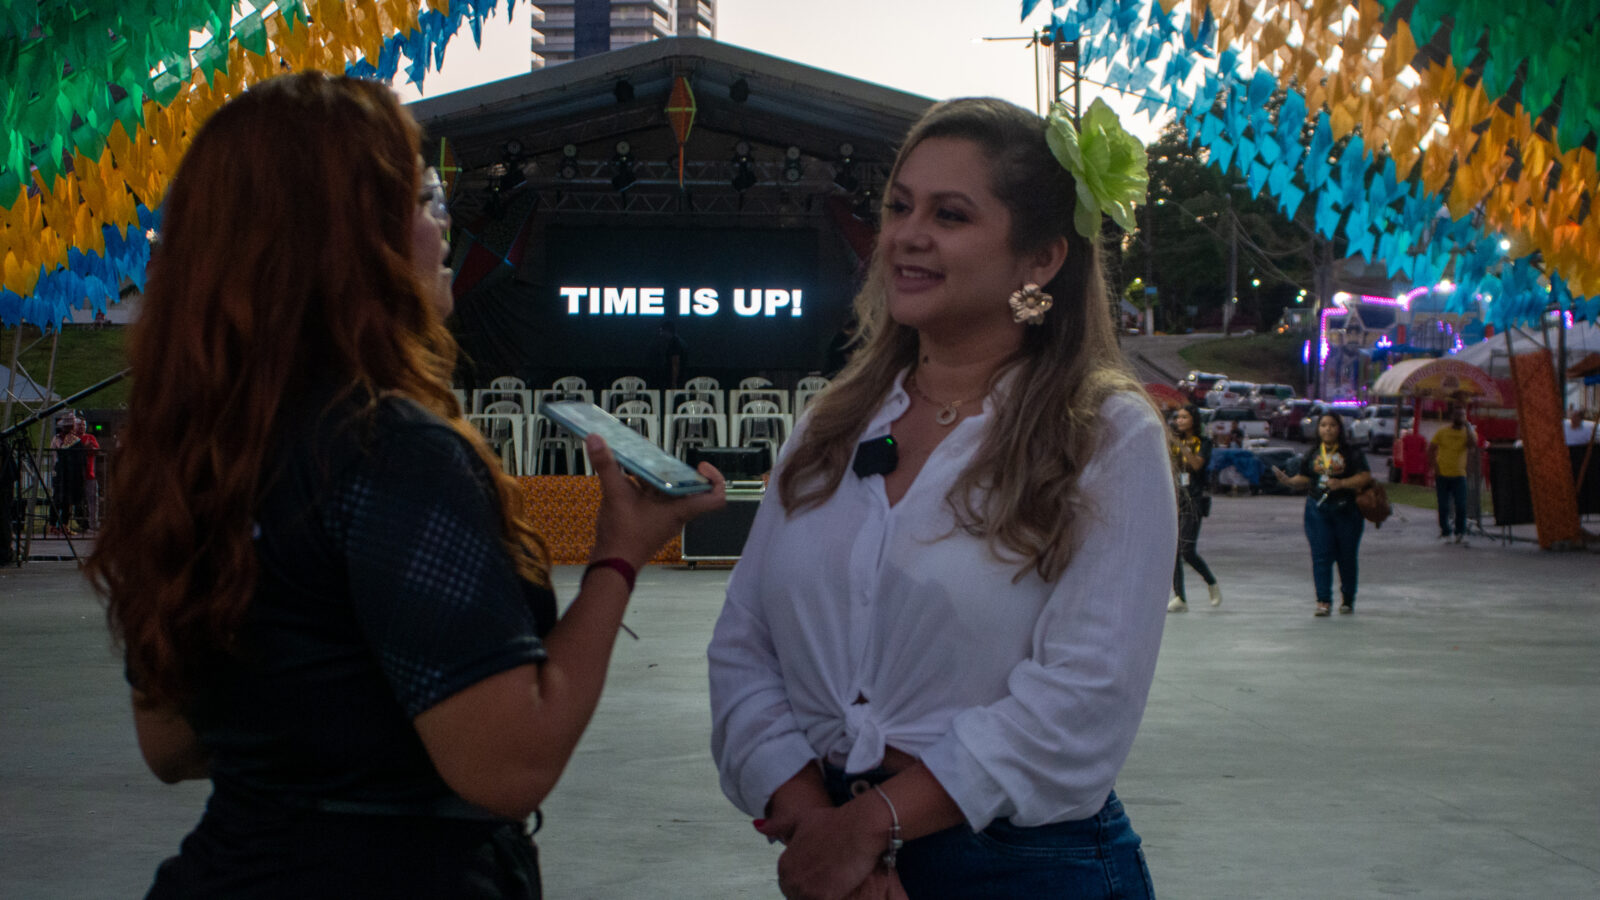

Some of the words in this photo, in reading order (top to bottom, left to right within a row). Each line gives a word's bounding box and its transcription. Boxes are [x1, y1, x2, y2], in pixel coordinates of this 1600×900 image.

[559, 287, 665, 315] TIME
[679, 288, 719, 316] IS
[733, 288, 802, 317] UP!
